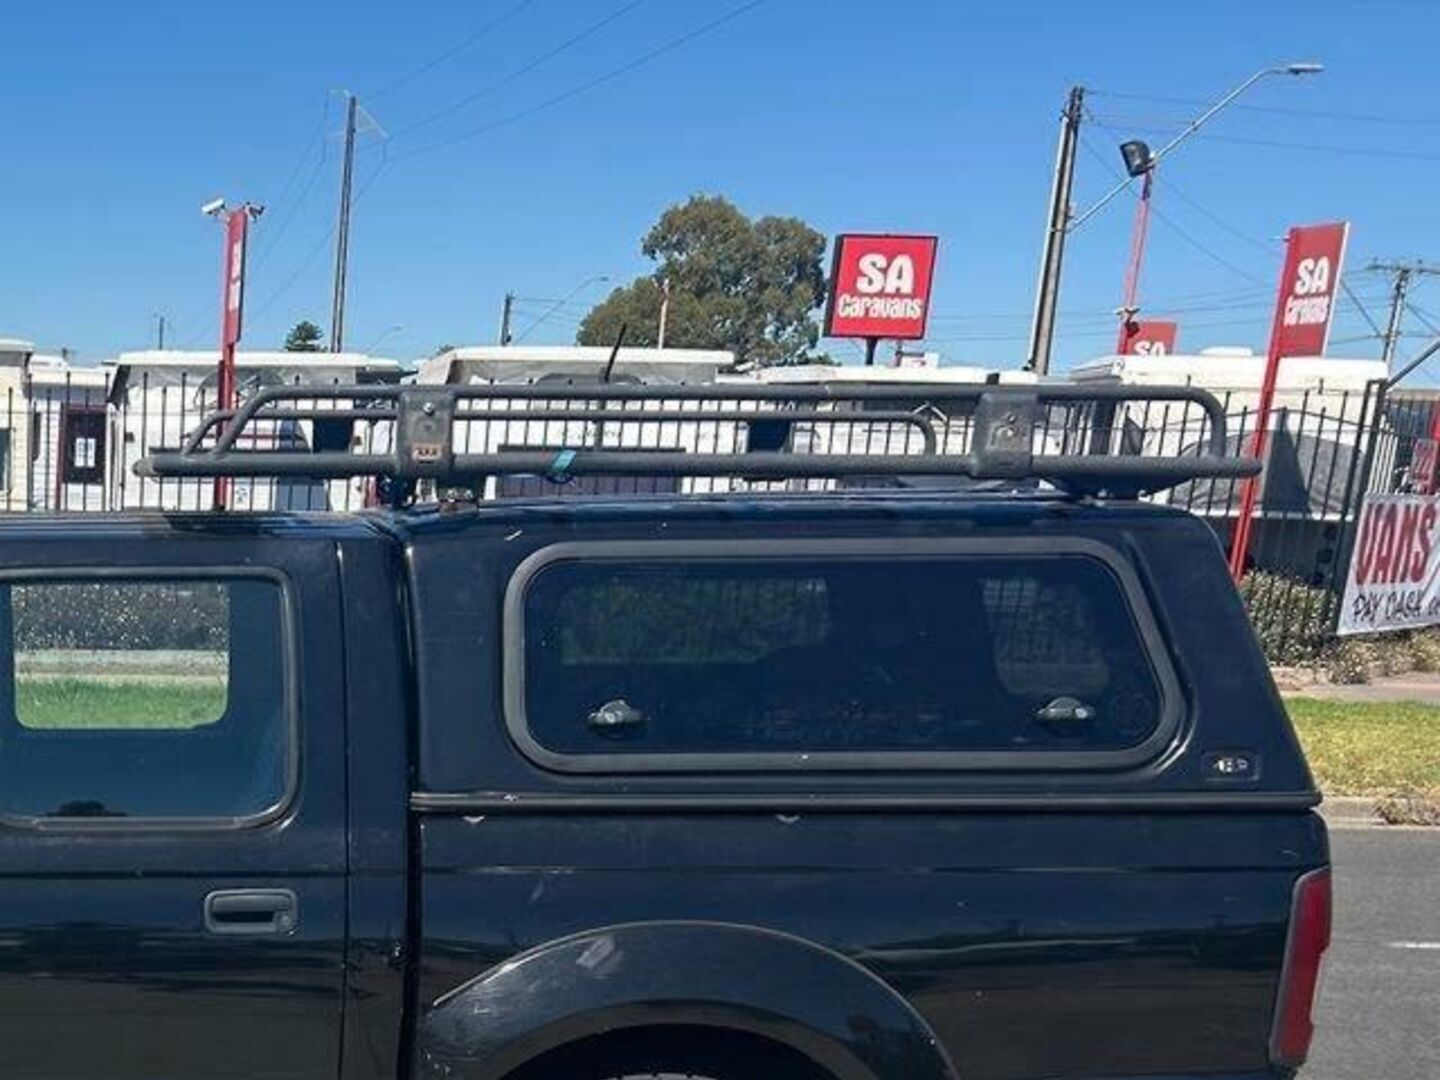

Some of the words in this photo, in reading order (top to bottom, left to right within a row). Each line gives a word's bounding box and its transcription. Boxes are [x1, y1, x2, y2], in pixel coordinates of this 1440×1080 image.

[857, 253, 915, 294] SA
[1293, 256, 1331, 295] SA
[837, 294, 923, 320] Caravans
[1356, 503, 1436, 586] VANS
